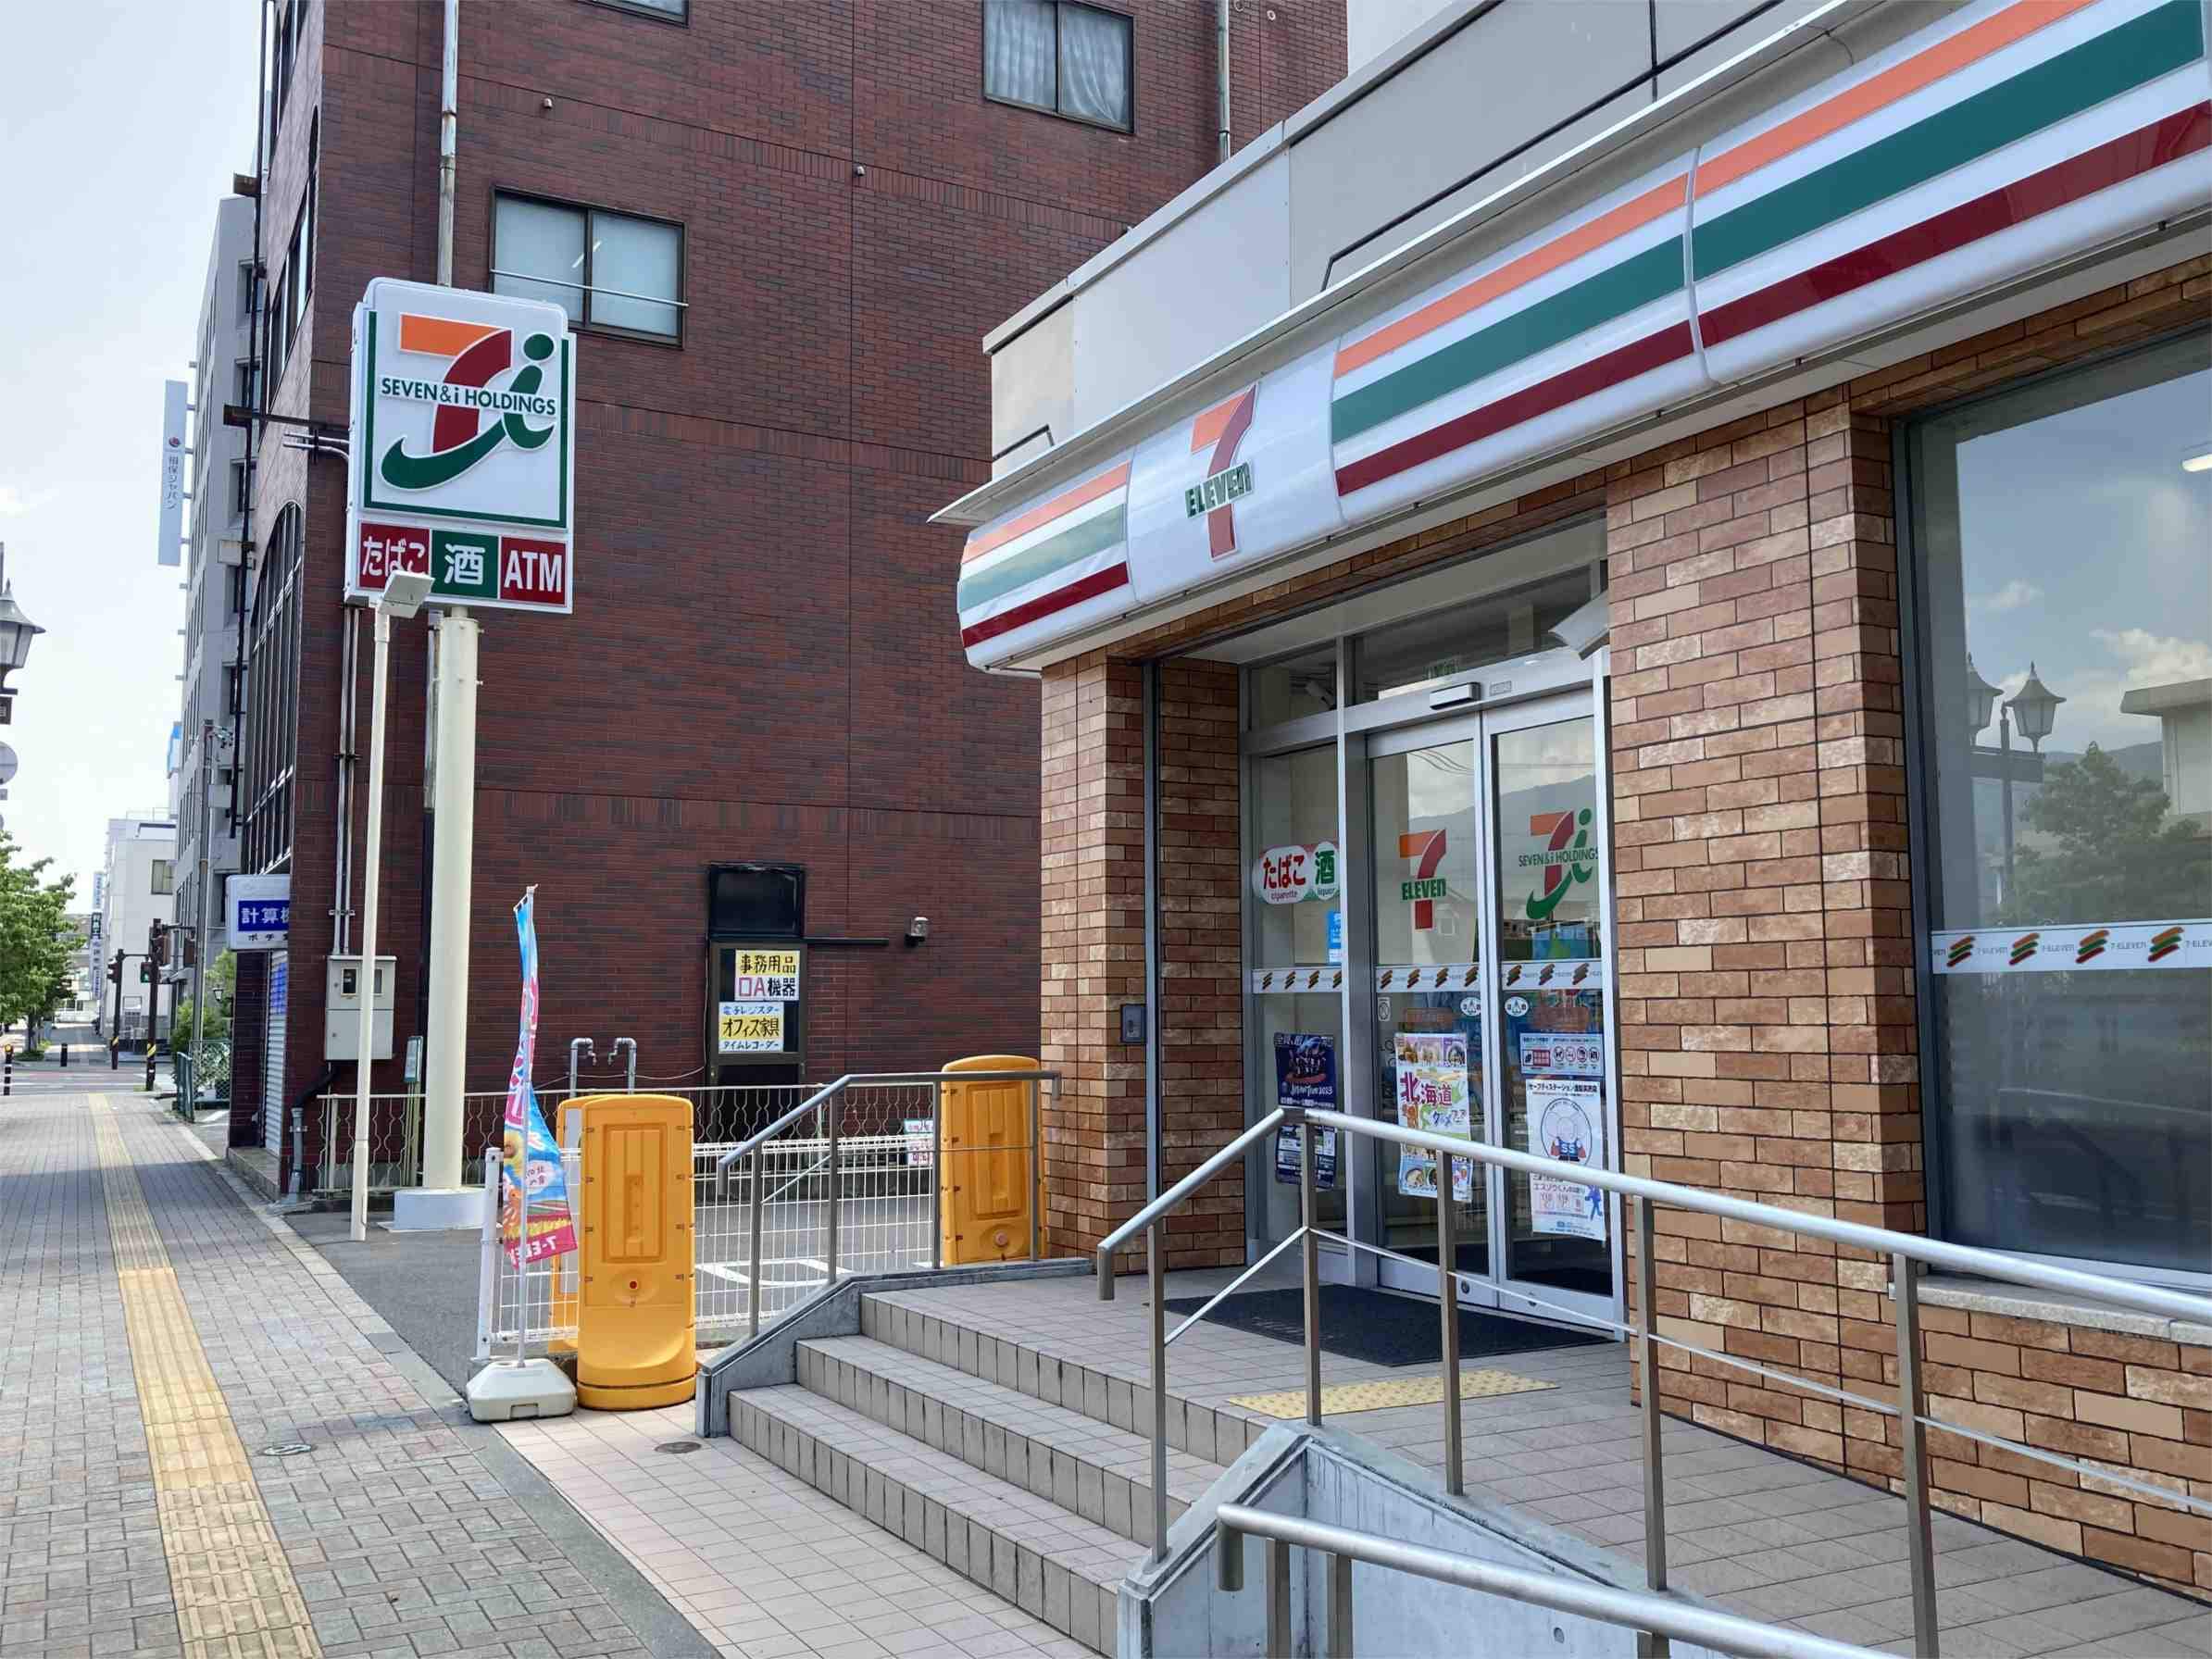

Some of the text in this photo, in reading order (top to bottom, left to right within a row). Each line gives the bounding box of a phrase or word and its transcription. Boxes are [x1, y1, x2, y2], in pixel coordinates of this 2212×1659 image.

[465, 390, 556, 417] HOLDINGS
[363, 536, 563, 593] たばこ 酒 ATM
[1263, 850, 1335, 890] たばこ 酒
[741, 954, 797, 974] 事務用品
[739, 977, 796, 997] OA機器
[722, 1017, 780, 1038] オフィス家具
[724, 1041, 780, 1050] タイムレコーダー
[1399, 1071, 1453, 1106] 北海道
[1561, 1142, 1576, 1154] SS
